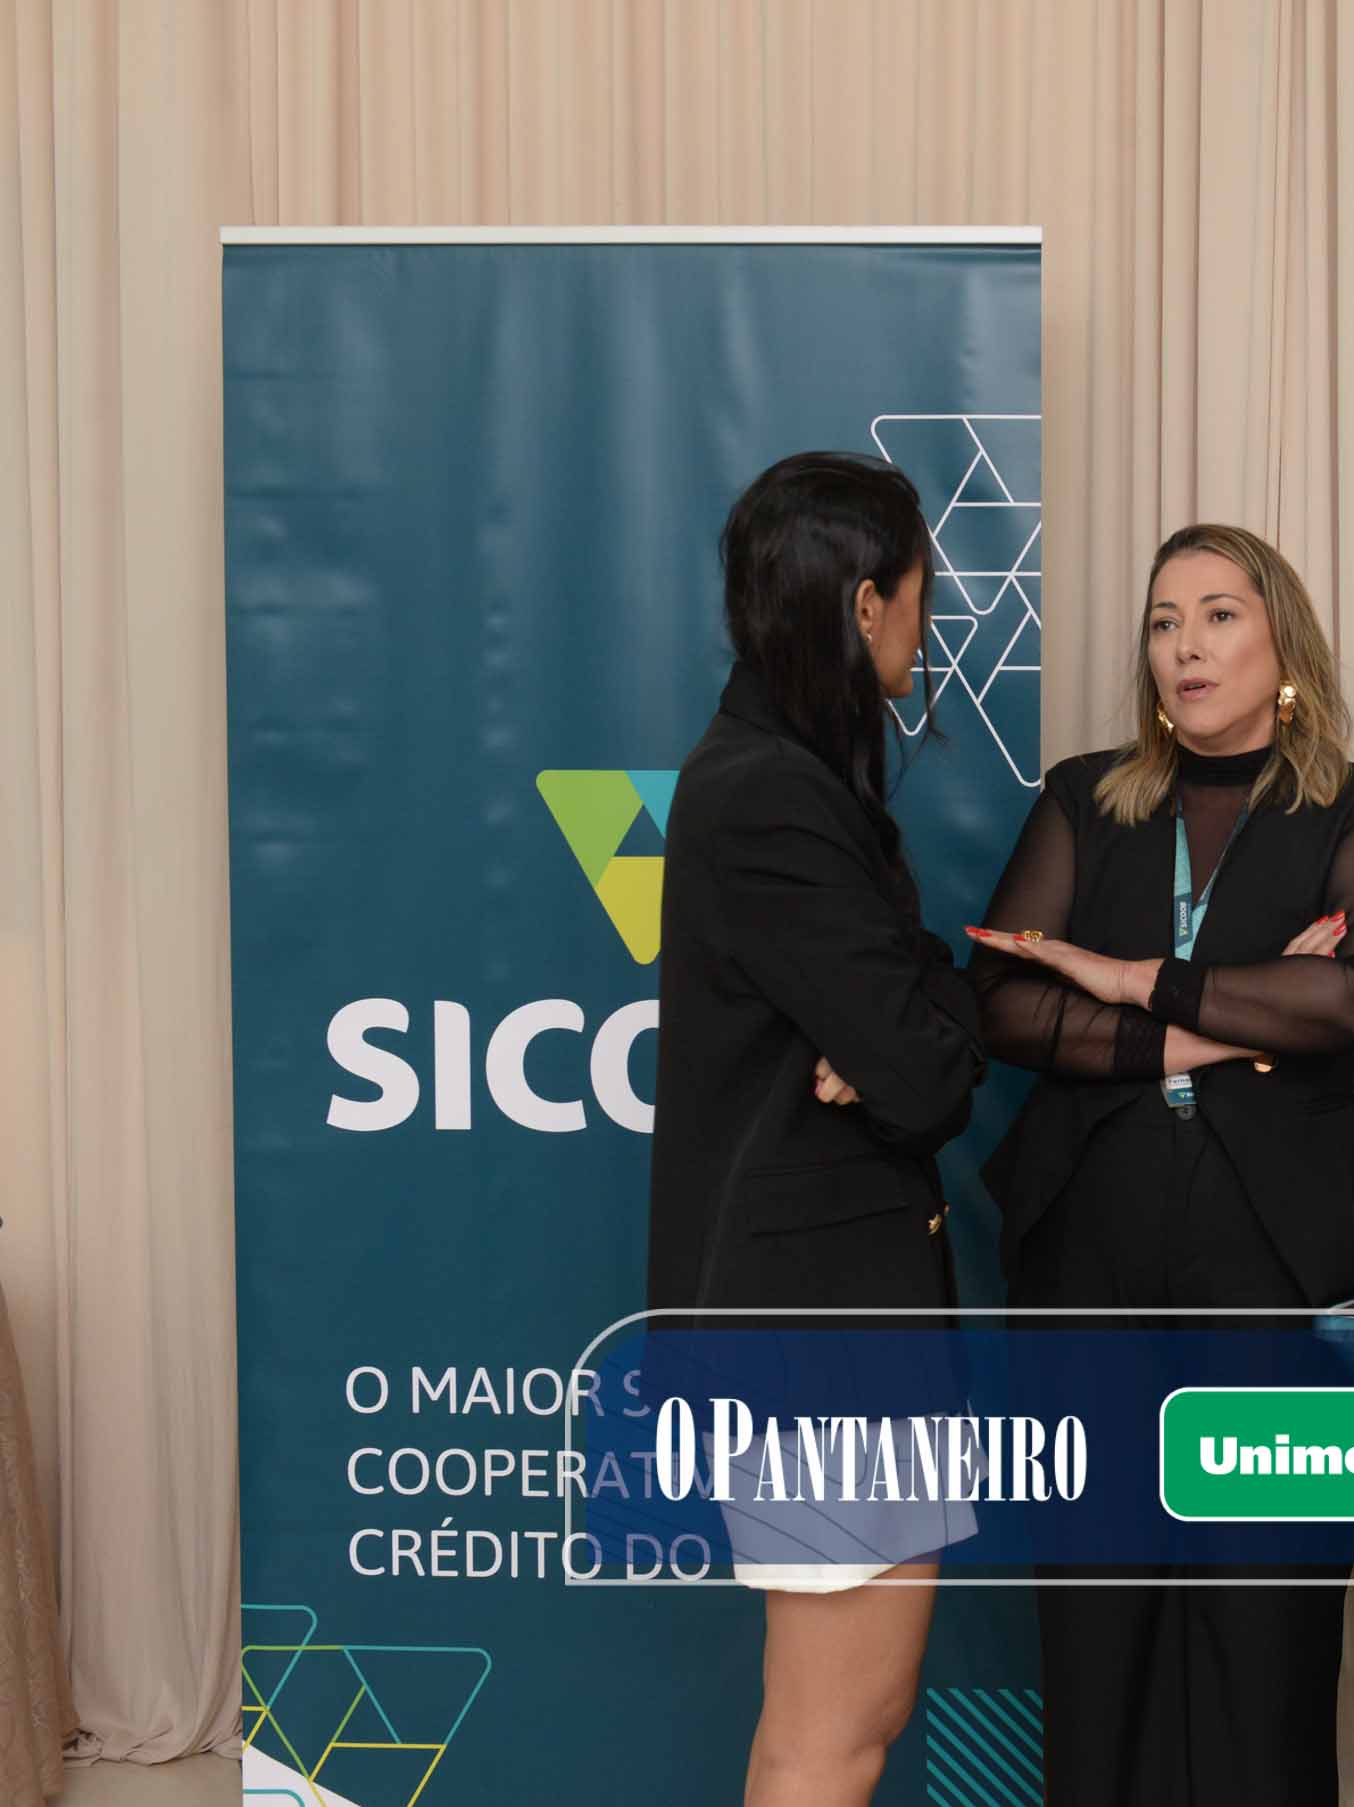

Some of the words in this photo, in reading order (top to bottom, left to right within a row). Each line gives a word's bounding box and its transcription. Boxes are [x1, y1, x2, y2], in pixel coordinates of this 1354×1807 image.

[345, 1366, 389, 1414] O
[411, 1366, 605, 1417] MAIOR
[349, 1516, 602, 1580] CRÉDITO
[626, 1533, 711, 1581] DO
